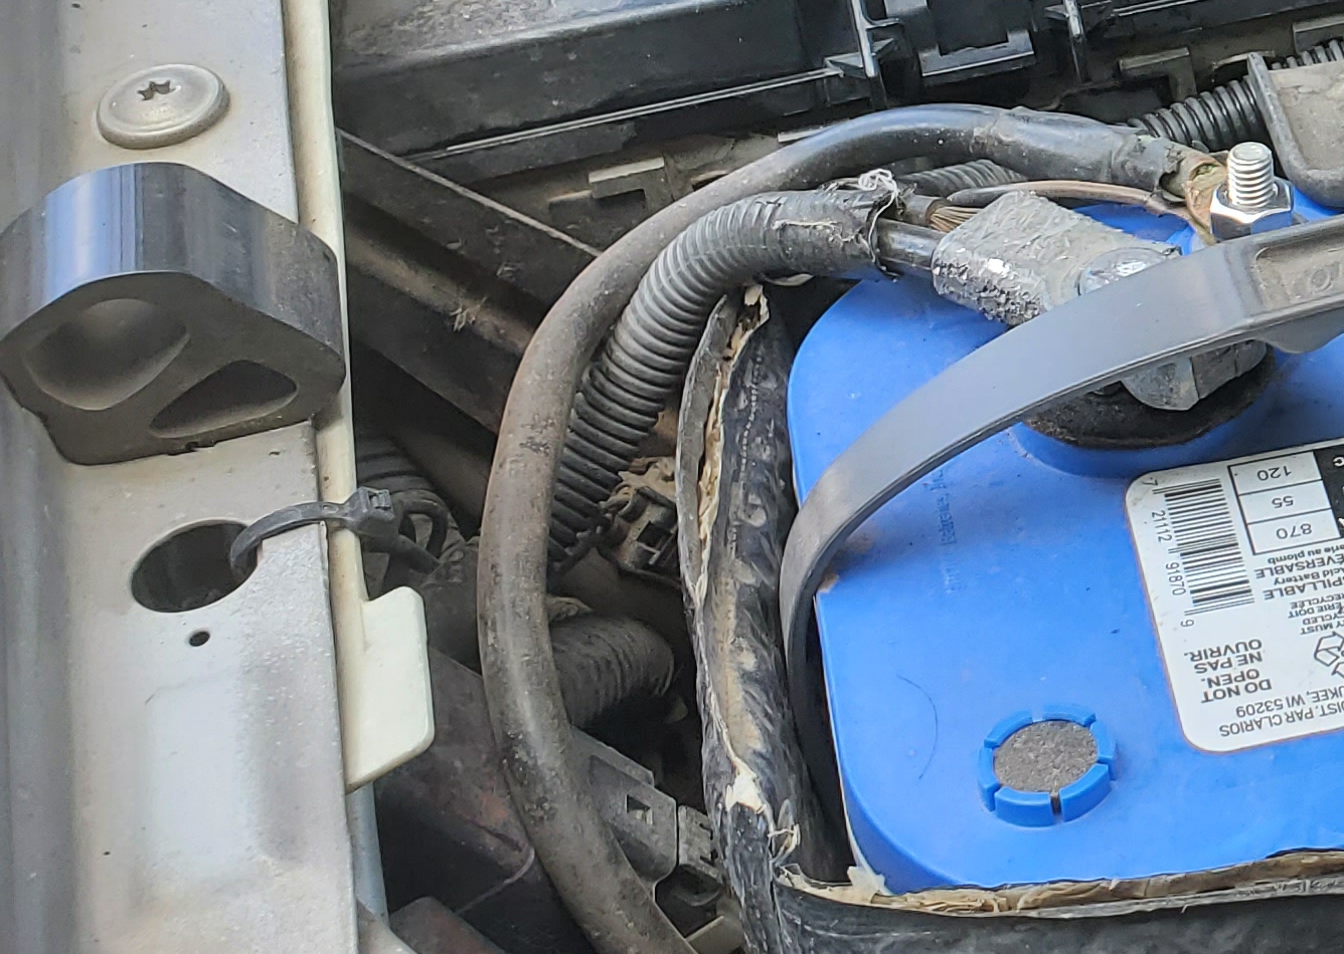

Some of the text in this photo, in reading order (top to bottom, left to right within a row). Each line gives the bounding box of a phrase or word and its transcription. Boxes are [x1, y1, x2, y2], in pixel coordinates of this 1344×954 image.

[1256, 465, 1292, 481] 120
[1271, 495, 1294, 509] 55
[1151, 509, 1173, 542] 21112
[1276, 523, 1312, 540] 870
[1267, 550, 1305, 565] plomb
[1307, 548, 1322, 557] au
[1165, 562, 1186, 596] 91870
[1273, 571, 1320, 586] Battery
[1288, 607, 1315, 619] DOIT
[1300, 622, 1334, 635] MUST
[1184, 639, 1262, 662] OUVRIR.
[1194, 651, 1263, 674] NE PAS
[1201, 668, 1260, 689] OPEN.
[1201, 679, 1272, 704] DO NOT
[1235, 698, 1284, 718] 53209
[1285, 694, 1306, 708] WI
[1284, 707, 1314, 724] PAR
[1219, 714, 1283, 737] CLARIOS
